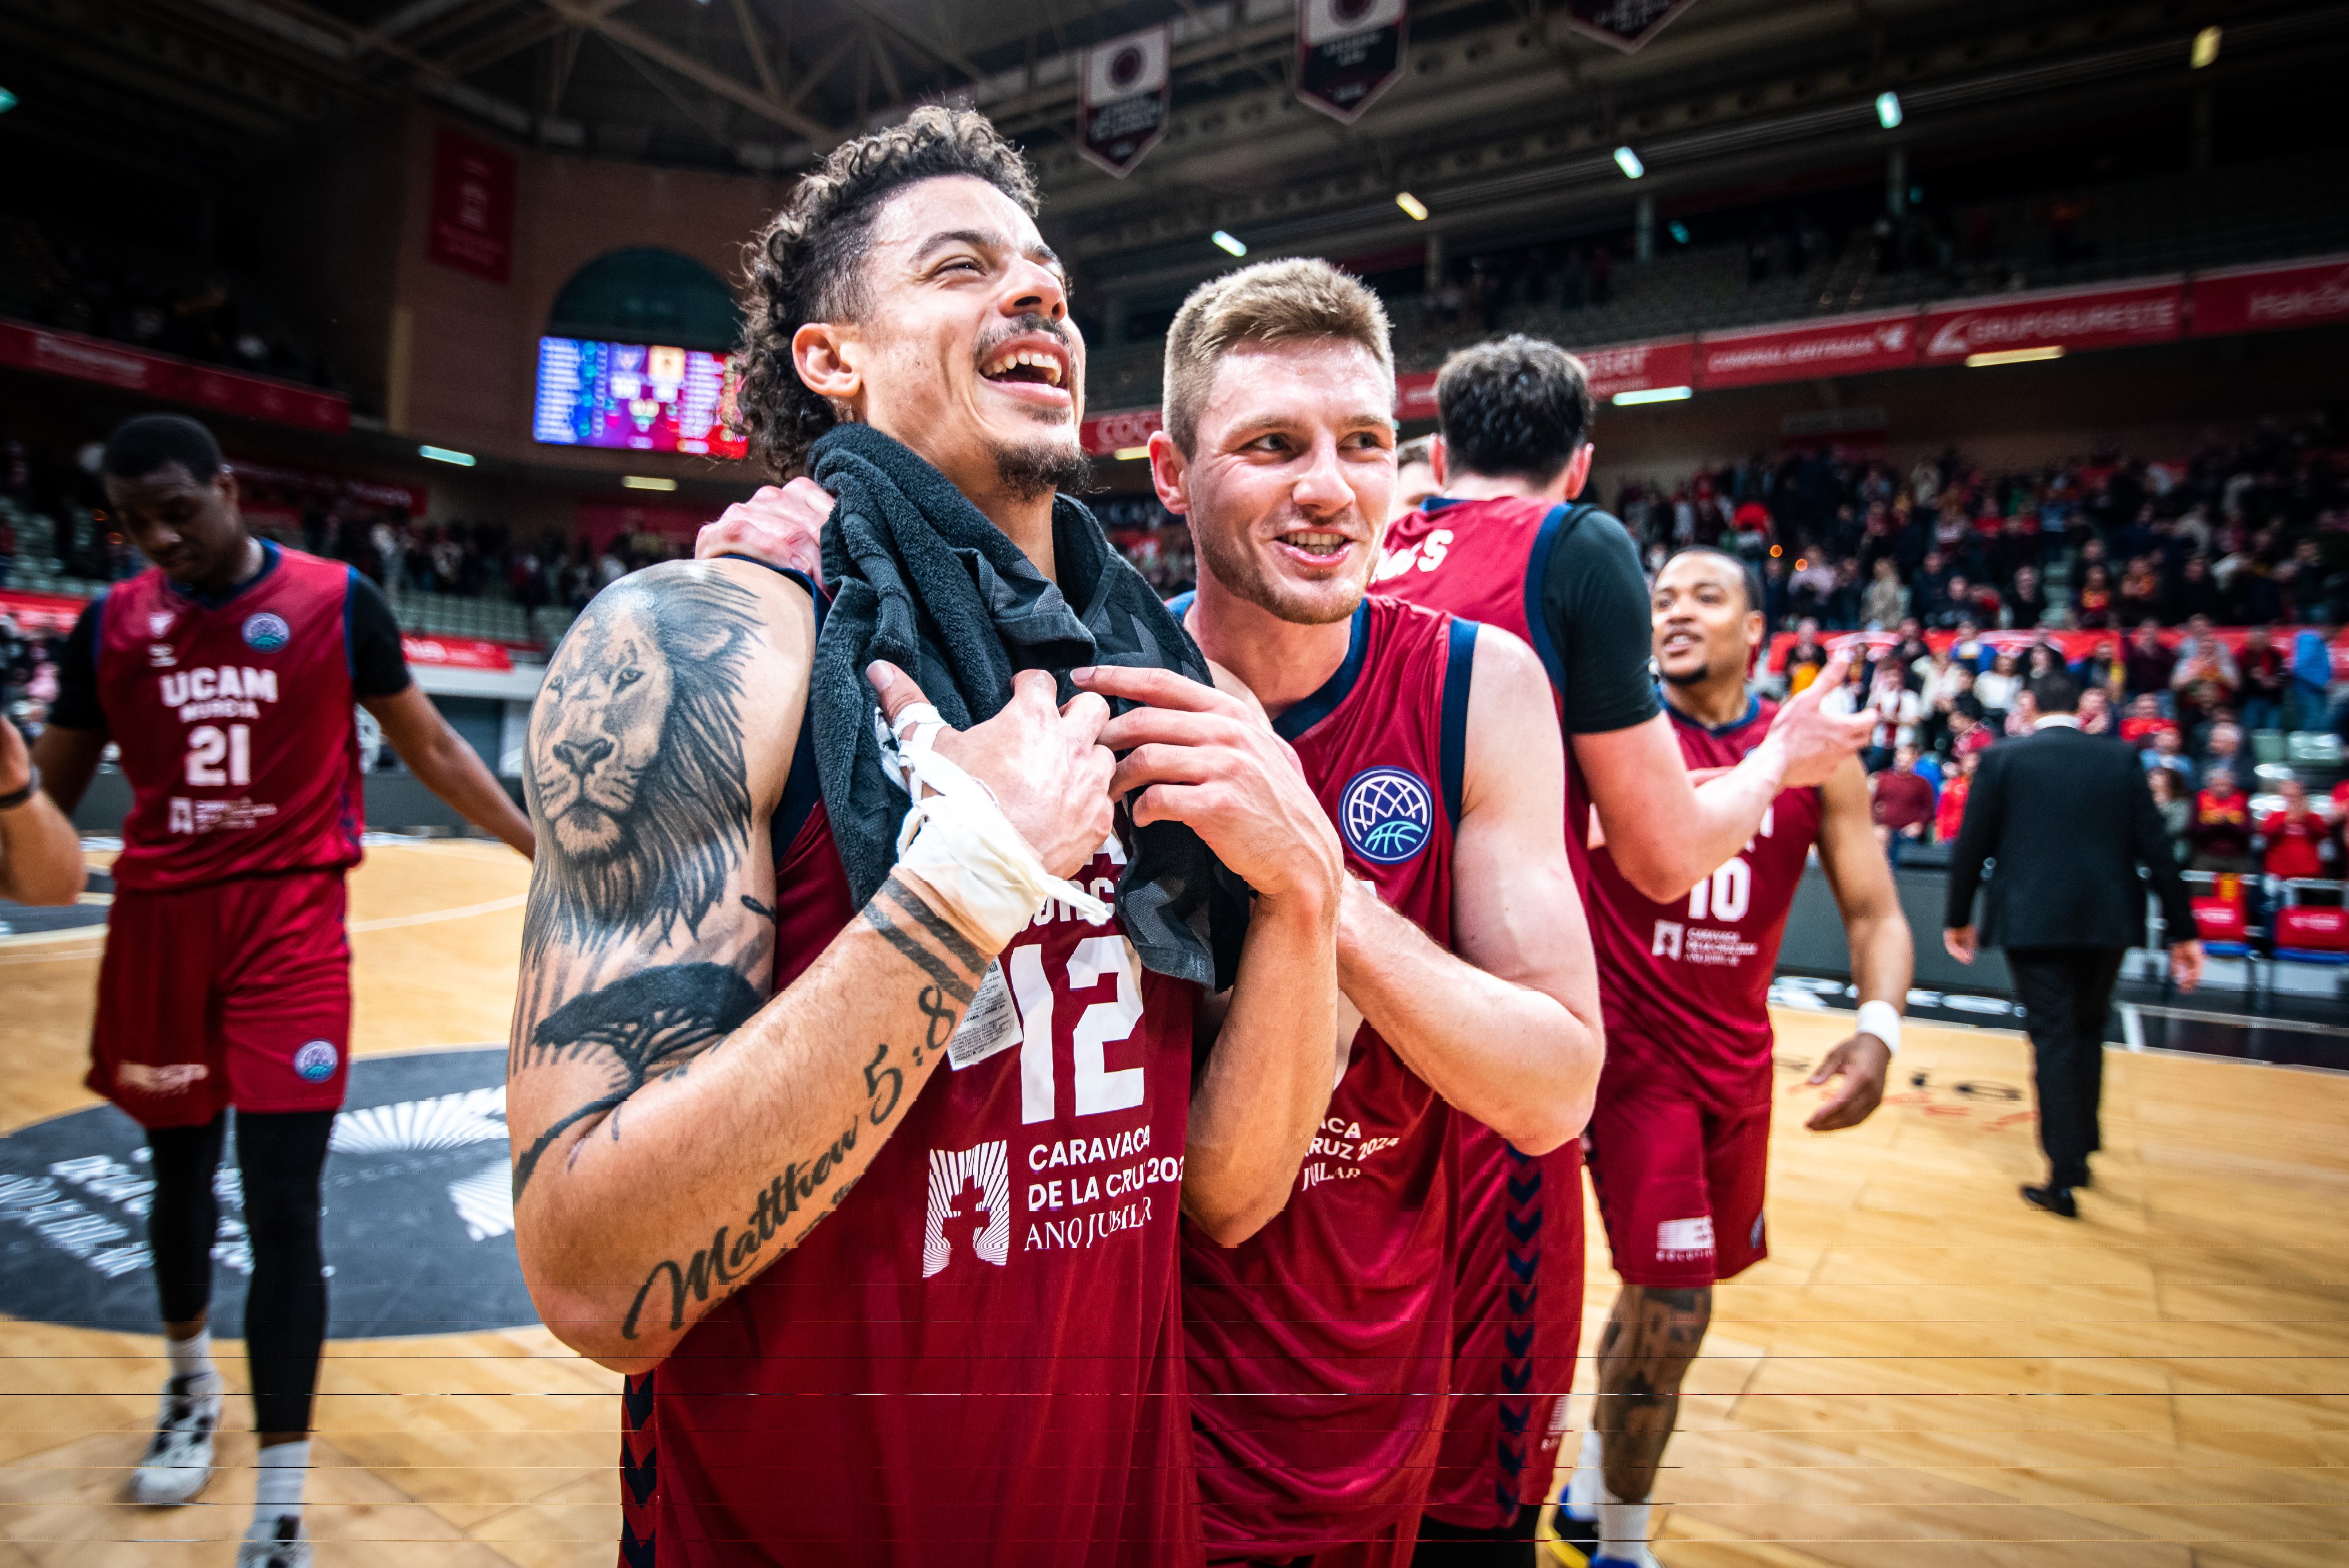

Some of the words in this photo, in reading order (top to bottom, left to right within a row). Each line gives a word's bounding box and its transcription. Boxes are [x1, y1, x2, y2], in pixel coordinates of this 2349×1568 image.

[159, 665, 279, 707] UCAM
[185, 724, 251, 786] 21
[1688, 857, 1751, 922] 10
[1010, 935, 1144, 1125] 12
[621, 1115, 859, 1339] Matthew
[863, 985, 957, 1125] 5:8
[1029, 1125, 1150, 1171] CARAVACA
[1305, 1138, 1355, 1160] RUZ
[1028, 1180, 1063, 1211] DE
[1071, 1176, 1099, 1205] LA
[1106, 1161, 1145, 1197] CRU
